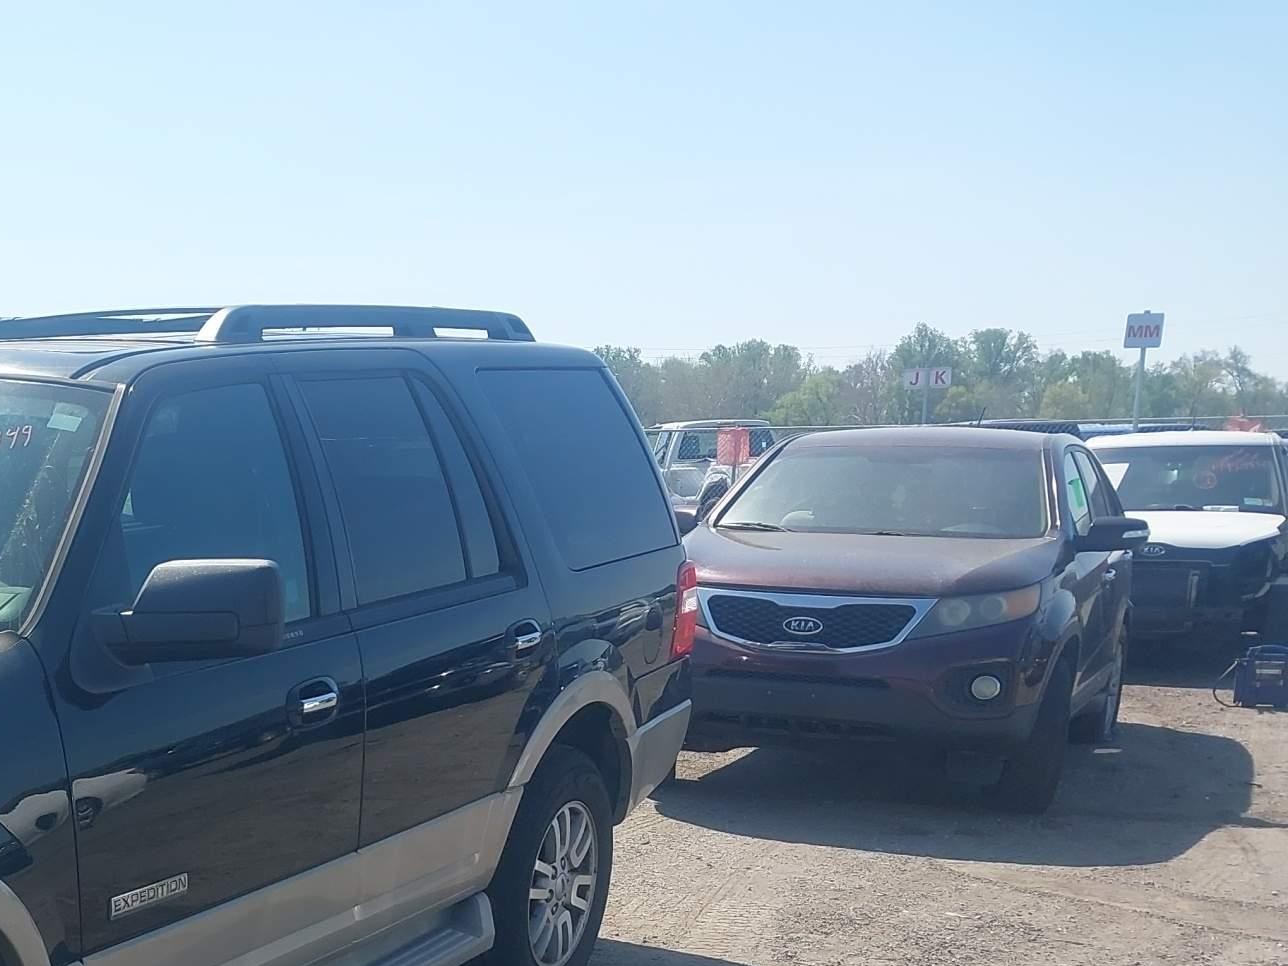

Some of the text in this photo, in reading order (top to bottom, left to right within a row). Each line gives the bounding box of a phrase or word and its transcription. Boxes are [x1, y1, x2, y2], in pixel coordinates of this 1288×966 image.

[1127, 324, 1161, 338] MM
[909, 371, 919, 386] J
[934, 370, 946, 385] K
[790, 620, 814, 631] KIA
[114, 876, 187, 913] EXPEDITION
